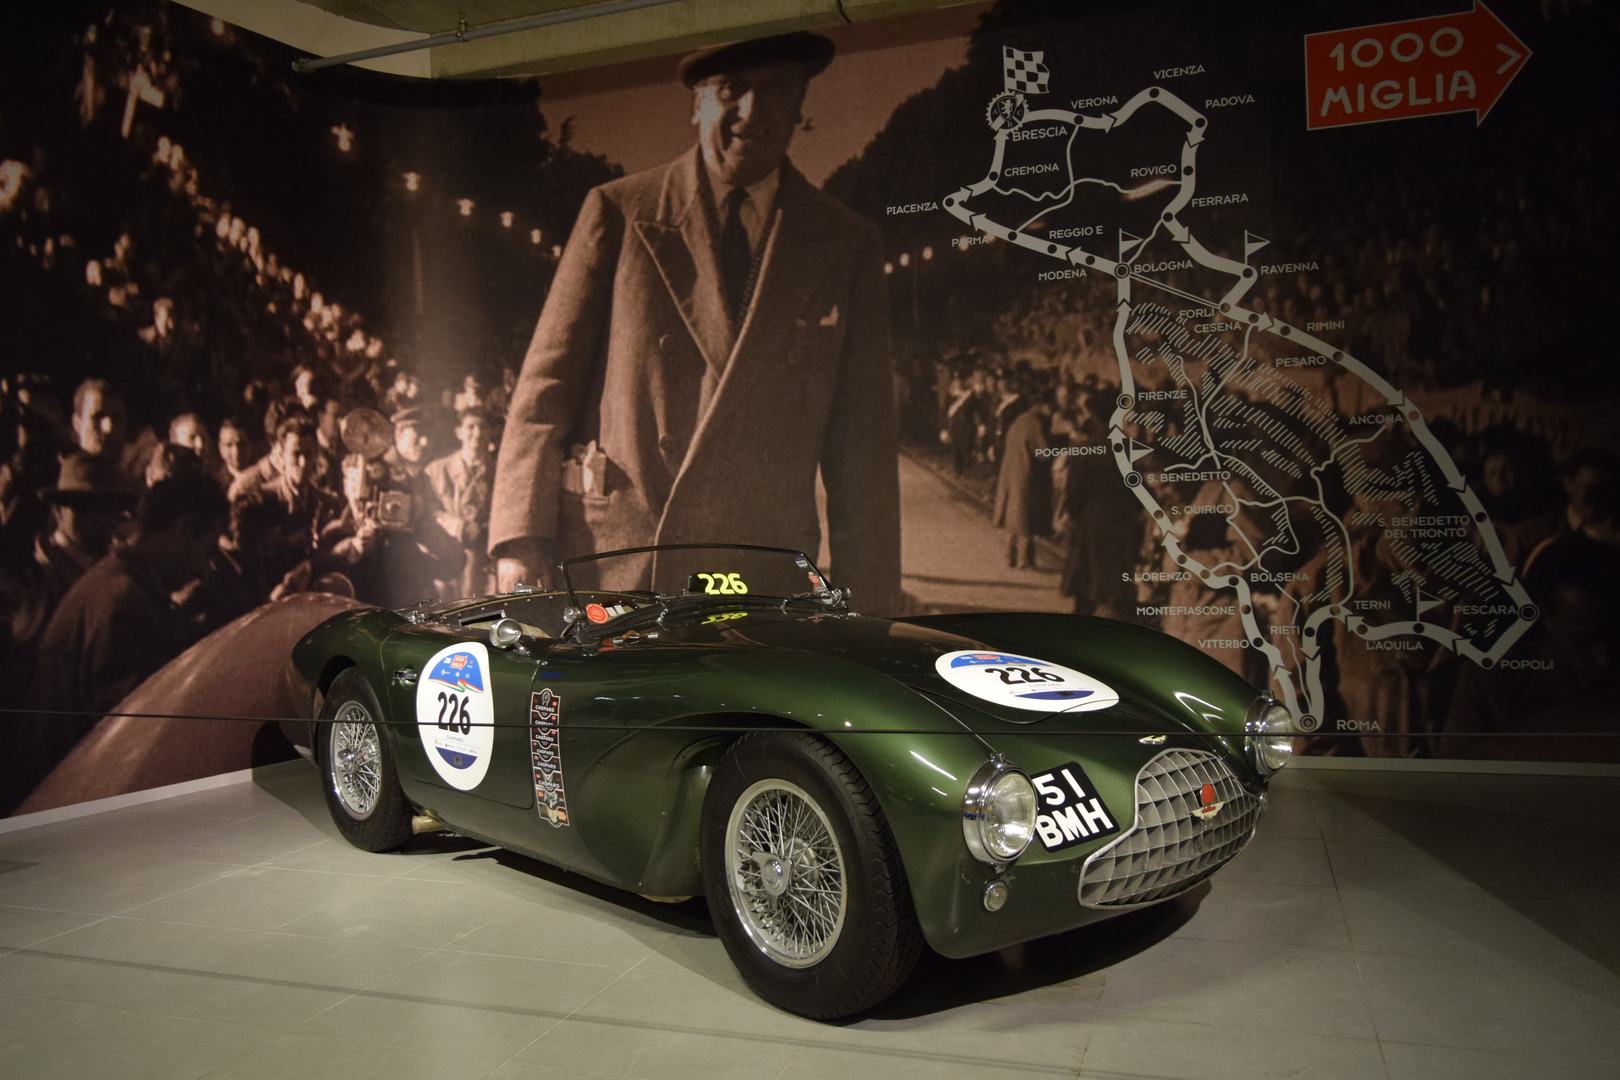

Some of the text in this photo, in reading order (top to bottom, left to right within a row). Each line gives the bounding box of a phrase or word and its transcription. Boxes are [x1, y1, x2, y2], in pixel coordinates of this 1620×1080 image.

[1329, 27, 1464, 71] 1000
[1153, 64, 1206, 80] VICENZA
[1320, 70, 1476, 117] MIGLIA
[1071, 95, 1118, 110] VERONA
[1205, 94, 1255, 109] PADOVA
[1012, 126, 1068, 142] BRESCIA
[1004, 163, 1060, 177] CREMONA
[1130, 164, 1177, 178] ROVIGO
[1191, 193, 1249, 208] FERRARA
[886, 201, 939, 216] PIACENZA
[1049, 225, 1104, 240] REGGIO E
[951, 235, 989, 248] PARMA
[1133, 260, 1194, 274] BOLOGNA
[1260, 261, 1320, 276] RAVENNA
[1038, 269, 1088, 282] MODENA
[1178, 308, 1215, 320] FORLI
[1194, 321, 1242, 334] CESENA
[1306, 320, 1346, 332] RIMINI
[1275, 355, 1327, 368] PESARO
[1138, 389, 1188, 402] FIRENZE
[1349, 413, 1404, 426] ANCONA
[1035, 446, 1107, 458] POGGIBONSI
[1147, 471, 1231, 483] S. BENEDETTO
[1171, 504, 1234, 516] S. QUIRICO
[1377, 515, 1471, 527] S. BENEDETTO
[1384, 527, 1467, 539] DEL TRONTO
[1122, 571, 1192, 582] S. LORENZO
[1250, 572, 1310, 583] BOLSENA
[697, 573, 748, 595] 226
[1136, 605, 1236, 616] MONTEFIASCONE
[1354, 600, 1391, 611] TERNI
[1453, 604, 1517, 616] PESCARA
[1270, 625, 1300, 636] RIETI
[1198, 639, 1250, 649] VITERBO
[1366, 640, 1424, 652] L'AQUILA
[1500, 659, 1554, 670] POPOLI
[984, 667, 1065, 685] 226
[437, 692, 471, 735] 226
[535, 705, 555, 713] CHOPARD
[1336, 719, 1381, 732] ROMA
[535, 734, 555, 743] CHOPARD
[536, 748, 555, 756] CHOPARD
[537, 761, 557, 770] CHOPARD
[538, 780, 560, 789] CHOPARD
[1032, 768, 1086, 806] 51
[1035, 798, 1114, 848] BMH
